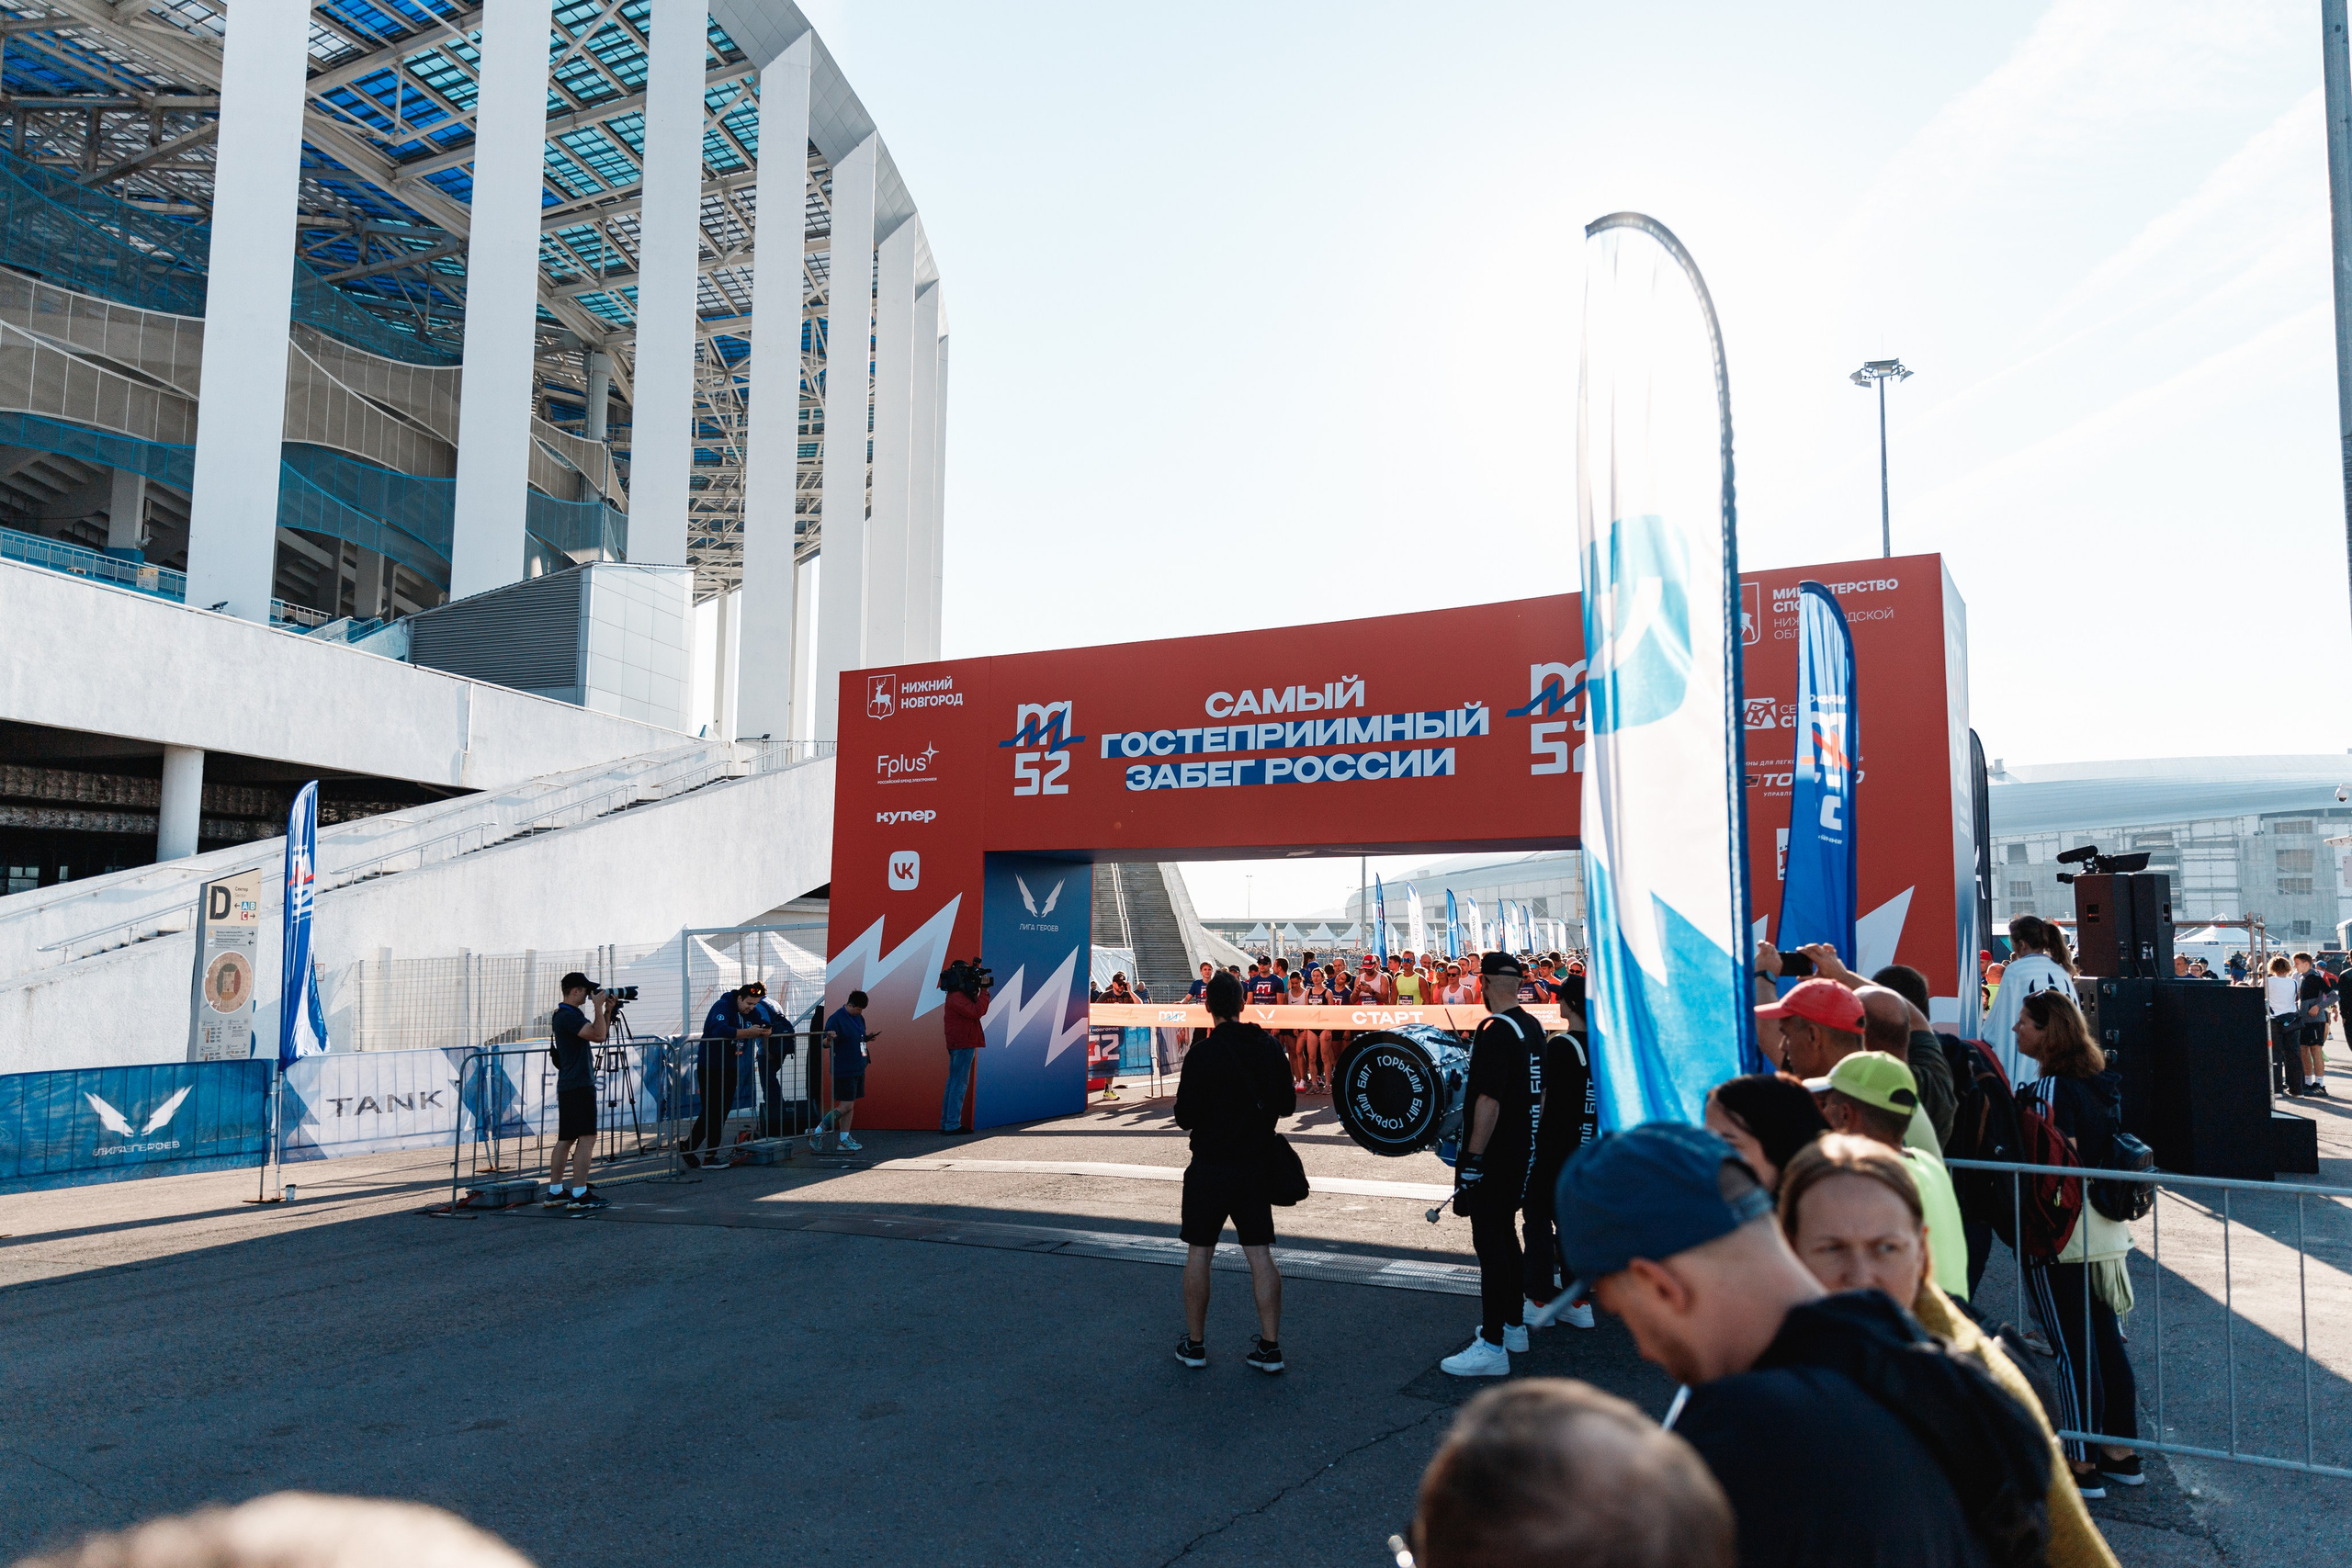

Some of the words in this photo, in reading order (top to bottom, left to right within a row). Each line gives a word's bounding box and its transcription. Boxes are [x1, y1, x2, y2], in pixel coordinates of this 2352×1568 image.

[1773, 579, 1899, 600] МИТЕРСТВО
[901, 676, 953, 694] НИЖНИЙ
[1204, 674, 1365, 718] САМЫЙ
[901, 693, 963, 709] НОВГОРОД
[1101, 701, 1489, 759] ГОСТЕПРИИМНЫЙ
[877, 754, 927, 778] Fplus
[1014, 750, 1070, 796] 52
[1125, 759, 1256, 791] ЗАБЕГ
[1265, 747, 1455, 784] РОССИИ
[876, 809, 936, 825] купер
[894, 863, 914, 880] VK
[209, 886, 232, 919] D
[1036, 924, 1058, 932] ГЕРОЕВ
[1351, 1010, 1424, 1025] СТАРТ
[1357, 1064, 1373, 1089] БИТ
[1530, 1053, 1542, 1094] БИТ
[1376, 1055, 1425, 1093] ГОРЬКИЙ
[1406, 1097, 1423, 1122] БИТ
[326, 1089, 445, 1118] TANK
[1356, 1093, 1404, 1130] ГОРЬКИЙ
[131, 1140, 181, 1153] ГЕРОЕВ
